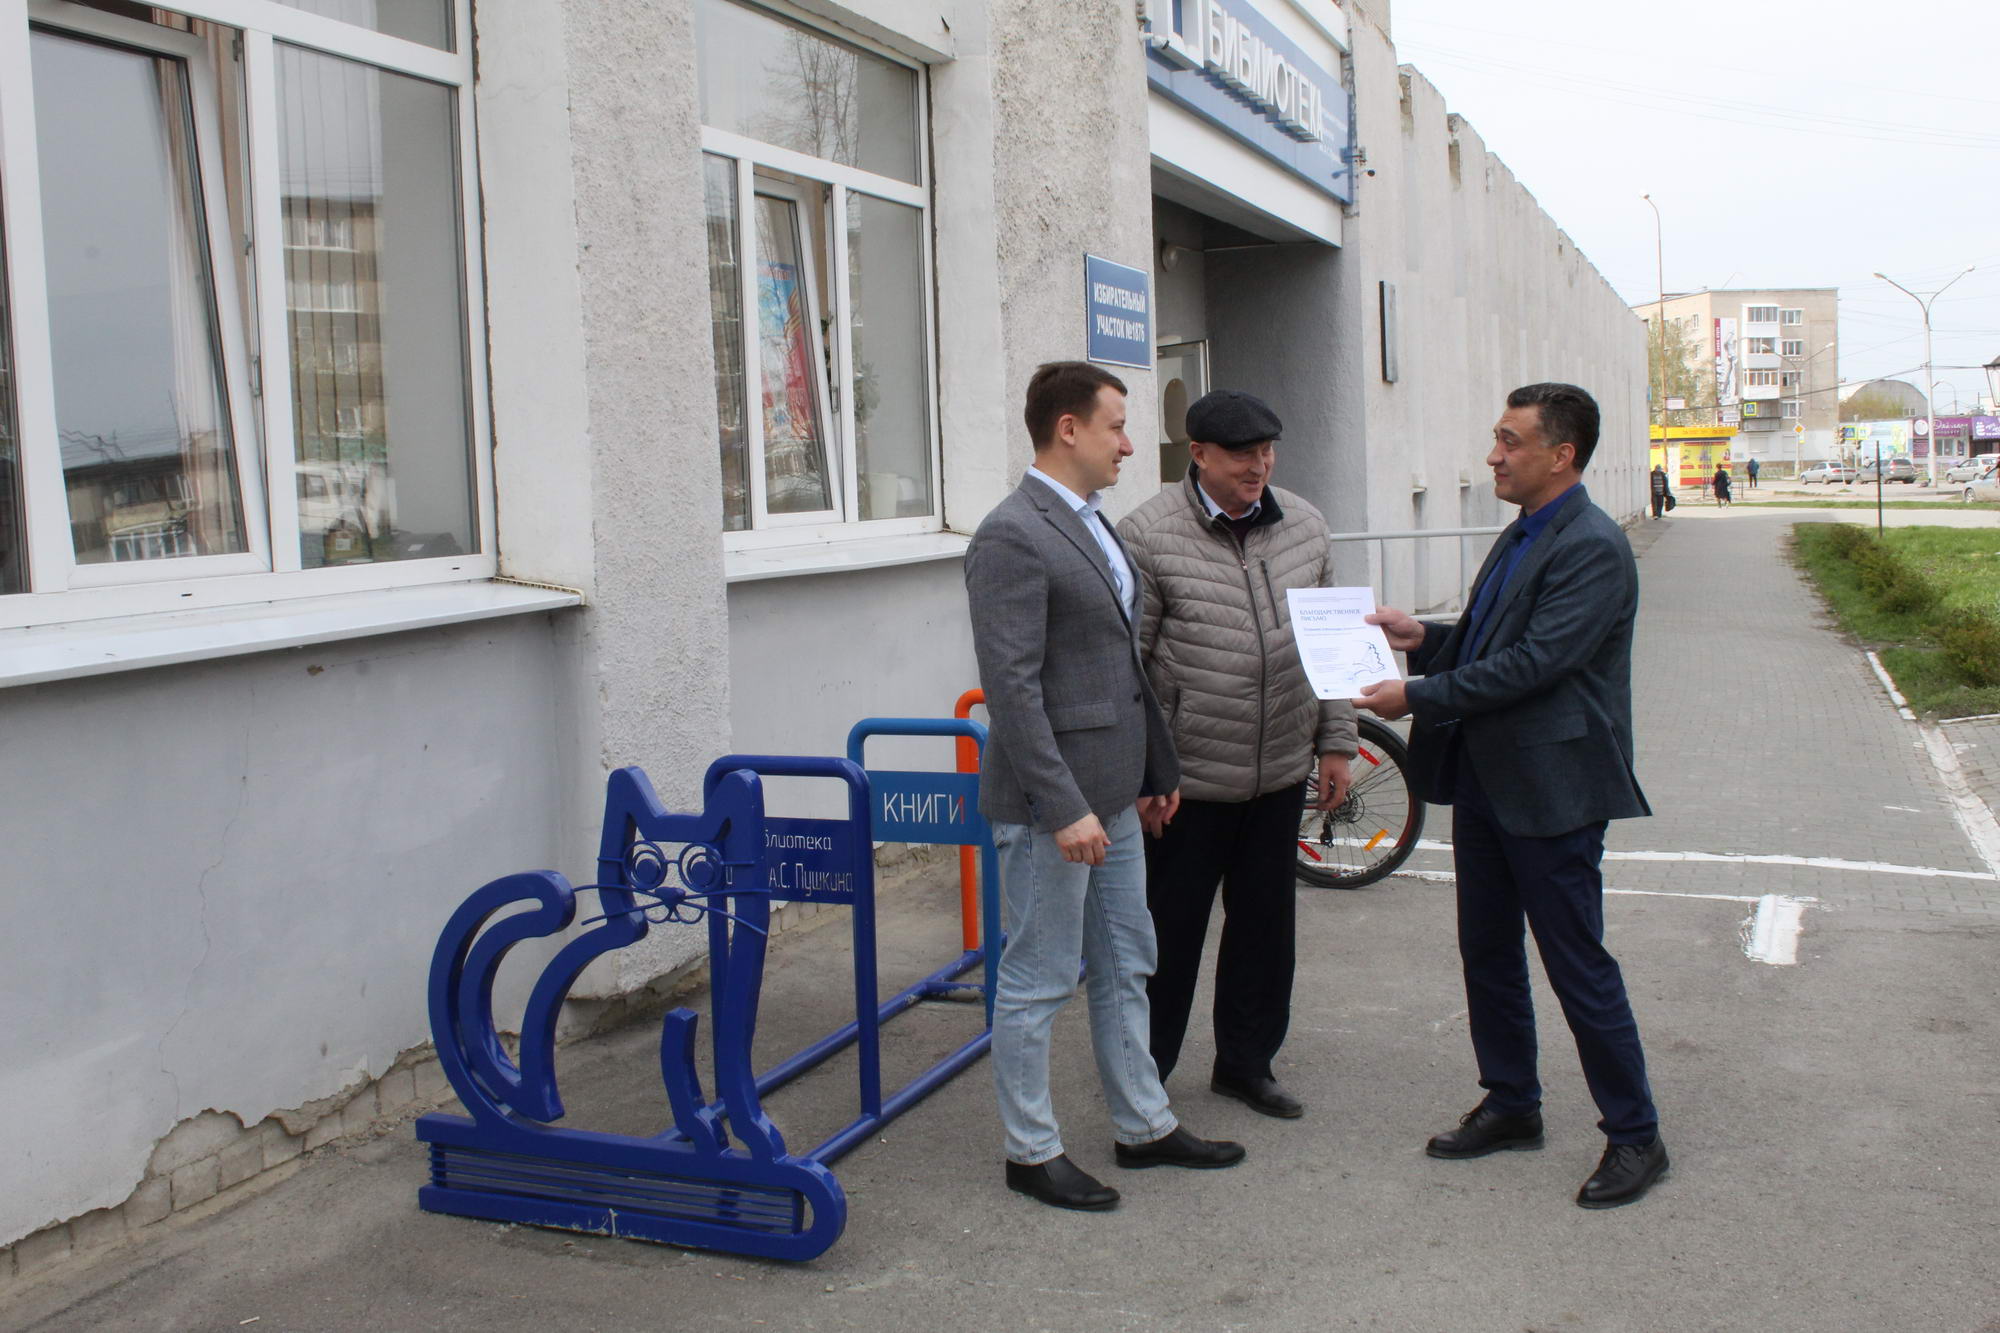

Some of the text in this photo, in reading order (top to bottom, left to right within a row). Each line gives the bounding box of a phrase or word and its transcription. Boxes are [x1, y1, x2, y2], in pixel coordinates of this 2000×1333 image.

[1094, 282, 1146, 313] ИЗБИРАТЕЛЬНЫЙ
[1096, 313, 1125, 339] УЧАСТОК
[884, 793, 964, 824] КНИГИ
[795, 863, 853, 897] Пушкина
